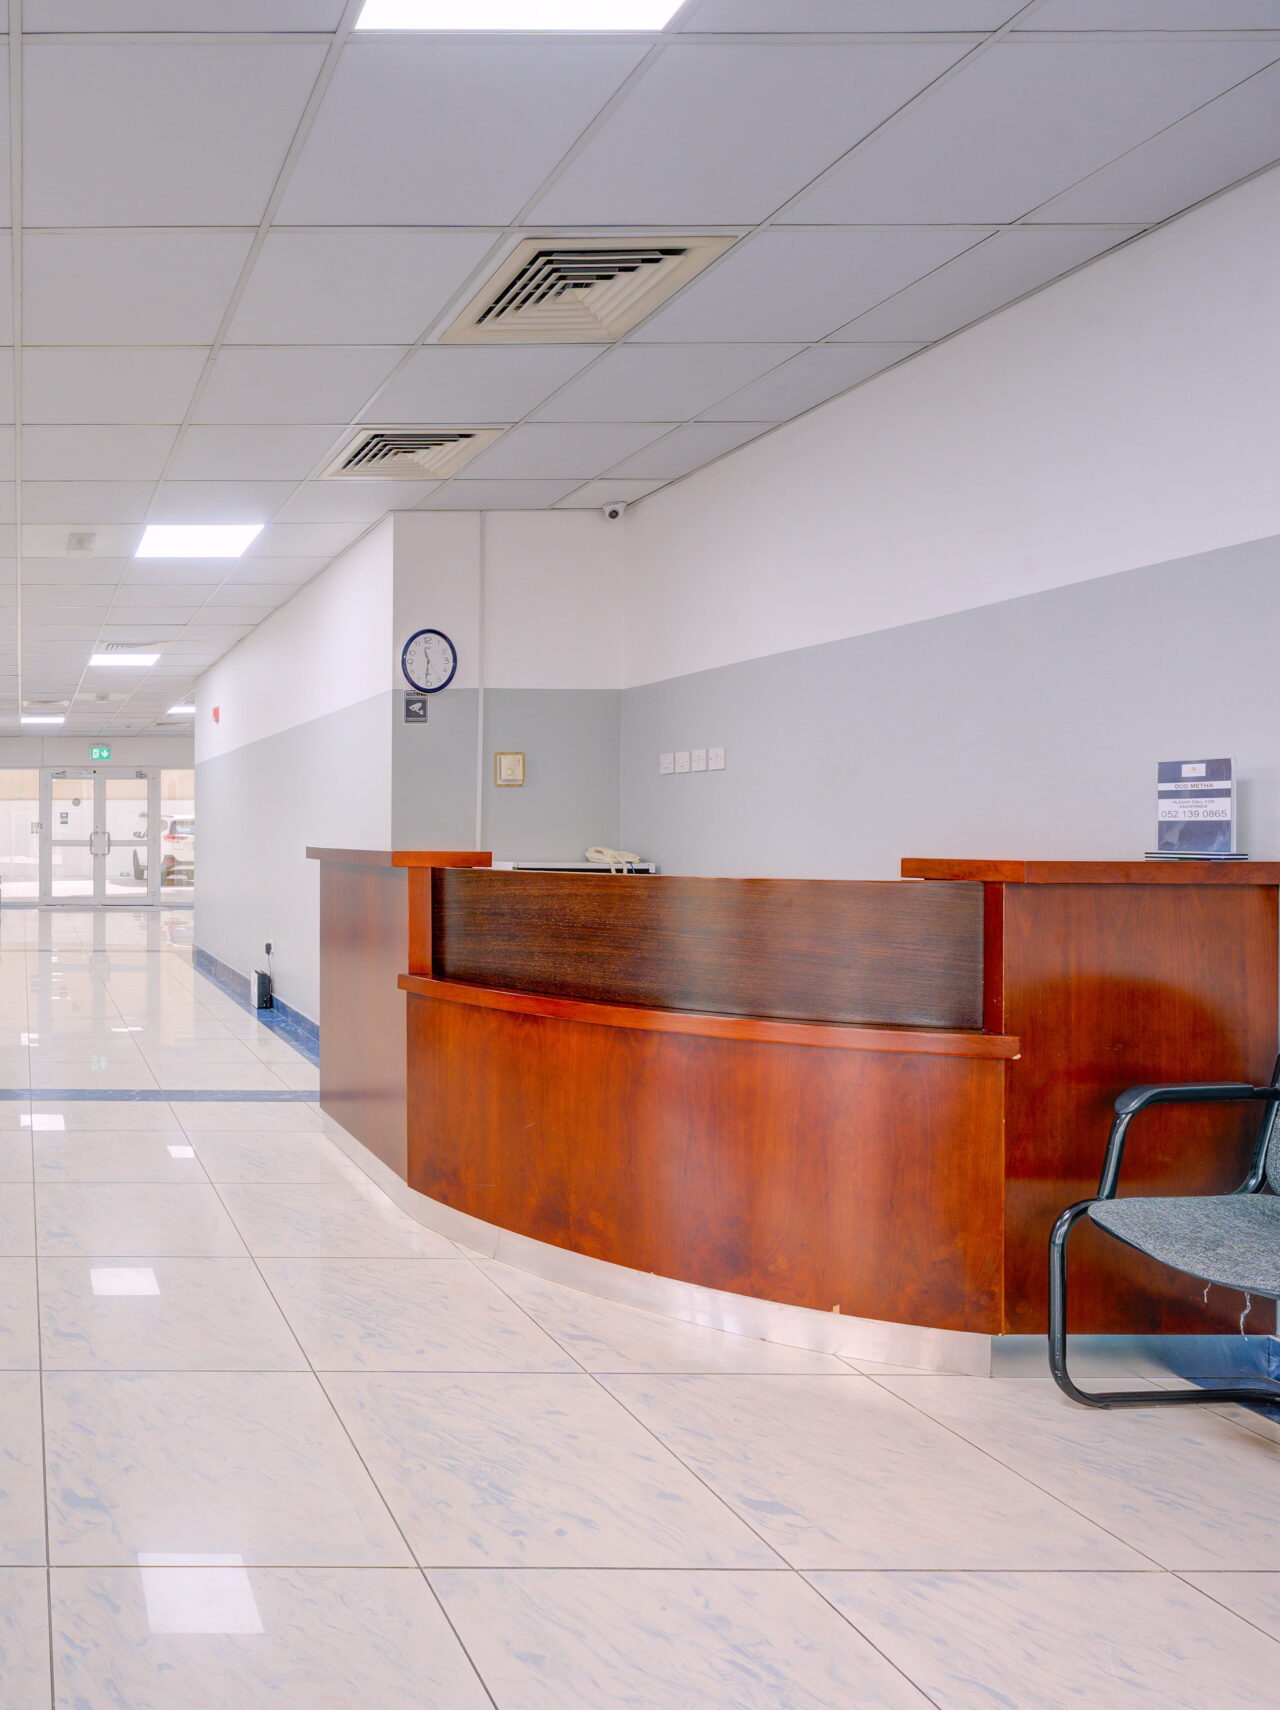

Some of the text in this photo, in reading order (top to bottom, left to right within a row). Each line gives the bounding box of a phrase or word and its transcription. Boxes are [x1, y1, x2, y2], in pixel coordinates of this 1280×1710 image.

[1161, 809, 1228, 818] 052 139 0865
